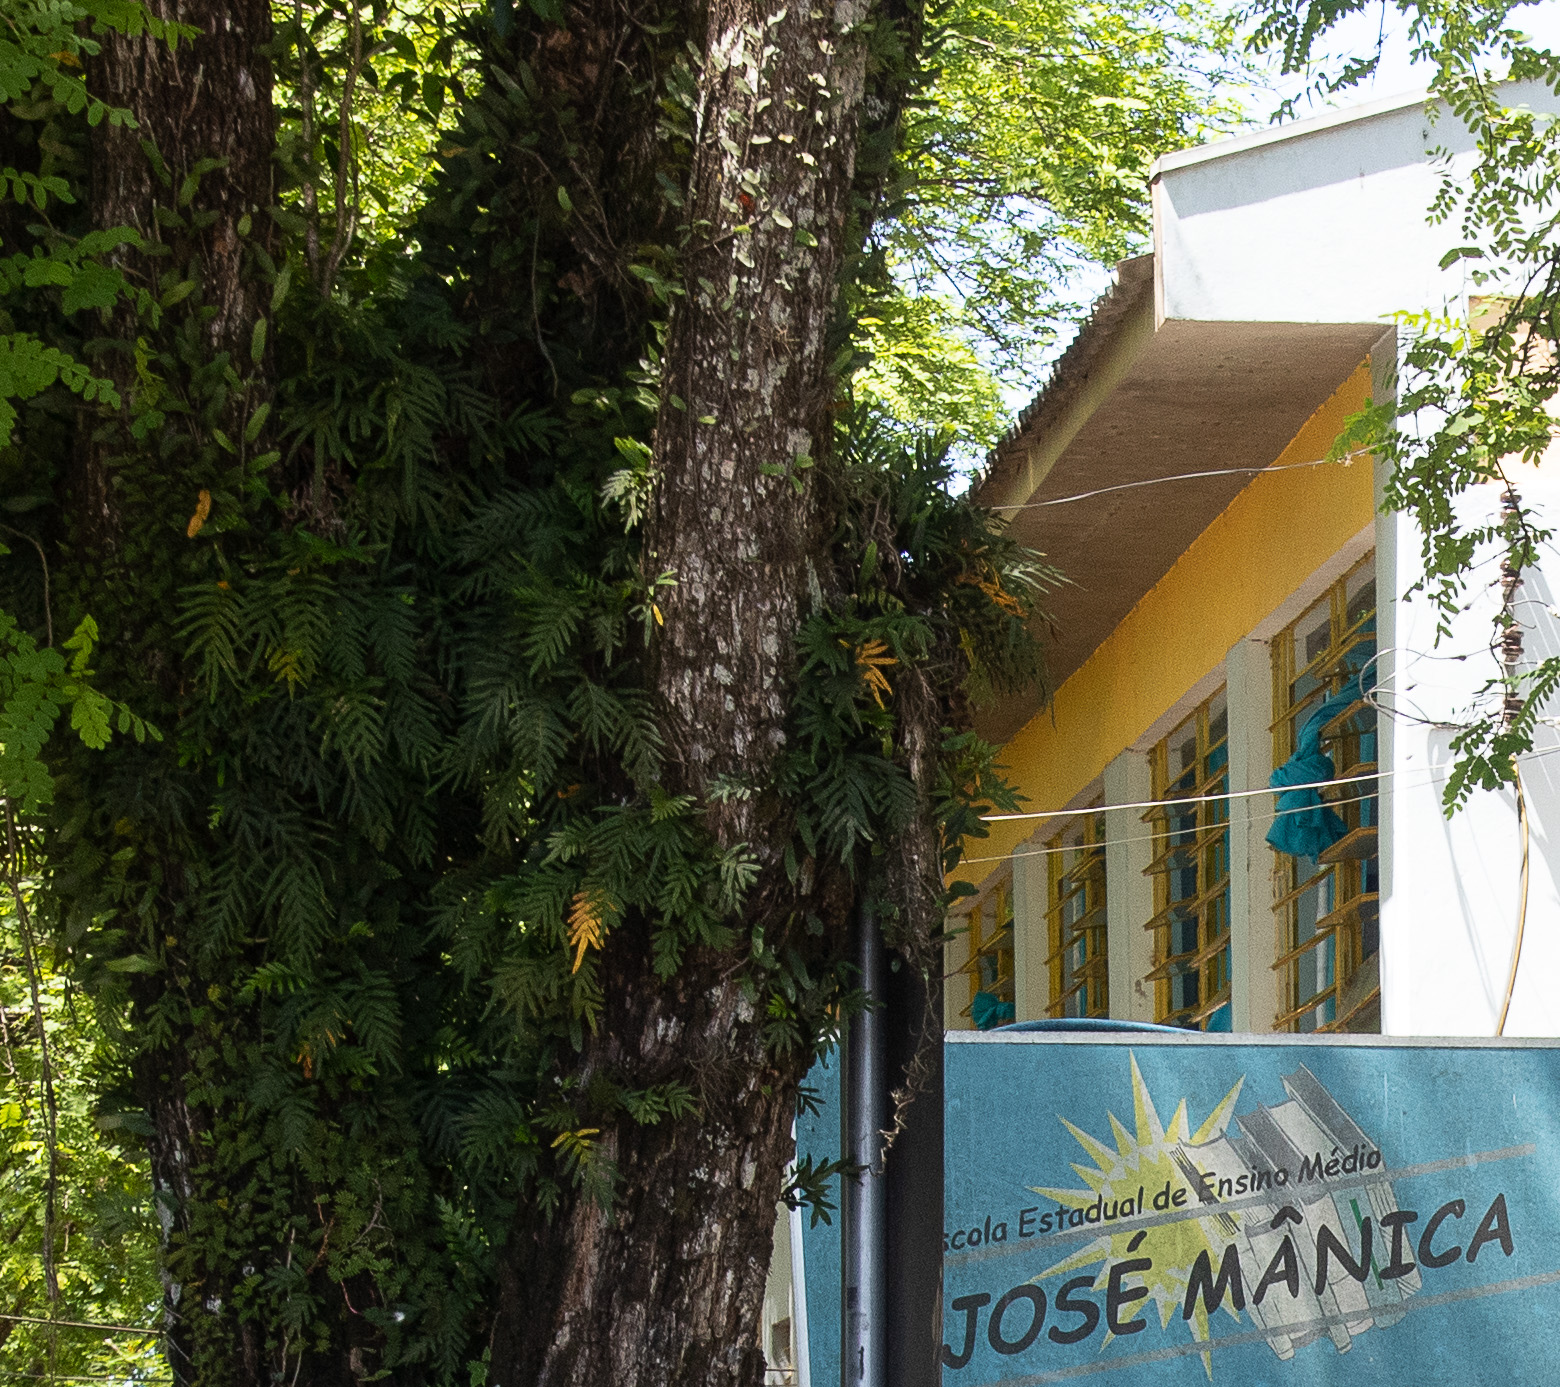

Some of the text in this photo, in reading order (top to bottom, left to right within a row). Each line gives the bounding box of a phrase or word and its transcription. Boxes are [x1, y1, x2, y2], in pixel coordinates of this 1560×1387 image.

[943, 1144, 1382, 1251] cola Estadual de Ensino Médio
[942, 1193, 1515, 1370] JOSÉ MÂNICA
